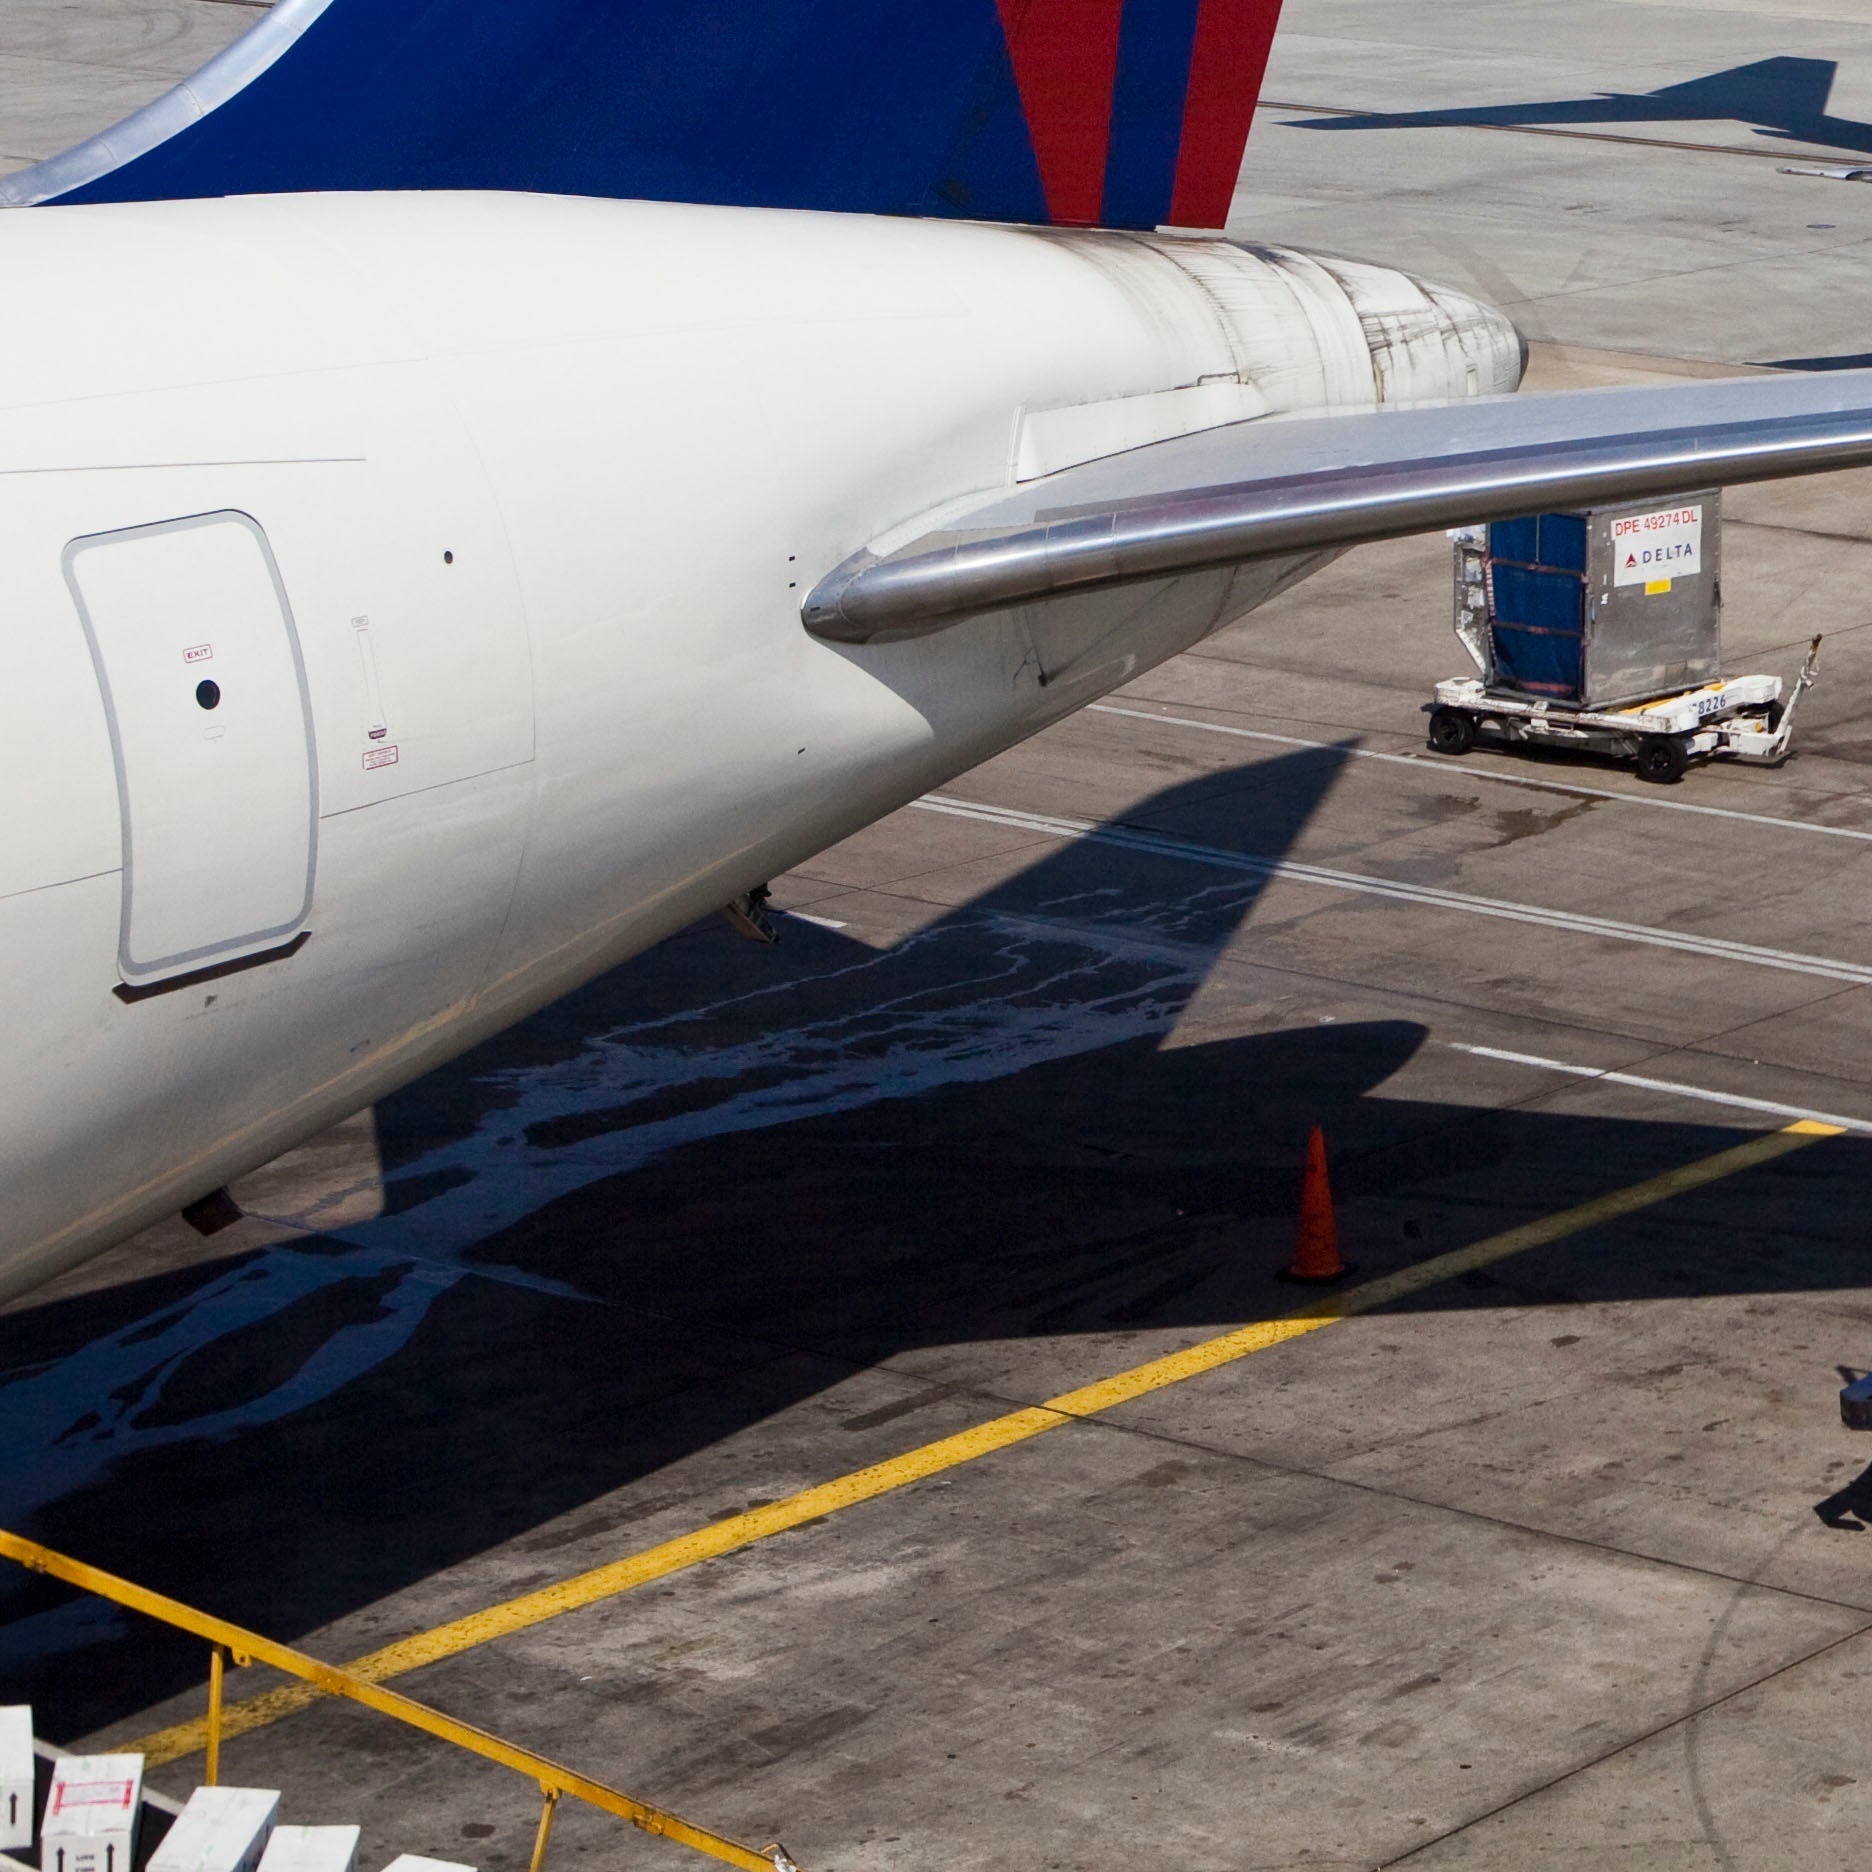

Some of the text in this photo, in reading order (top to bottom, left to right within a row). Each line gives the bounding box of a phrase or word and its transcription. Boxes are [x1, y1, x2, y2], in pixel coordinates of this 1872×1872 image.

[1615, 510, 1698, 536] DPE 49274 DL
[1642, 543, 1693, 564] DELTA
[187, 648, 208, 659] EXIT
